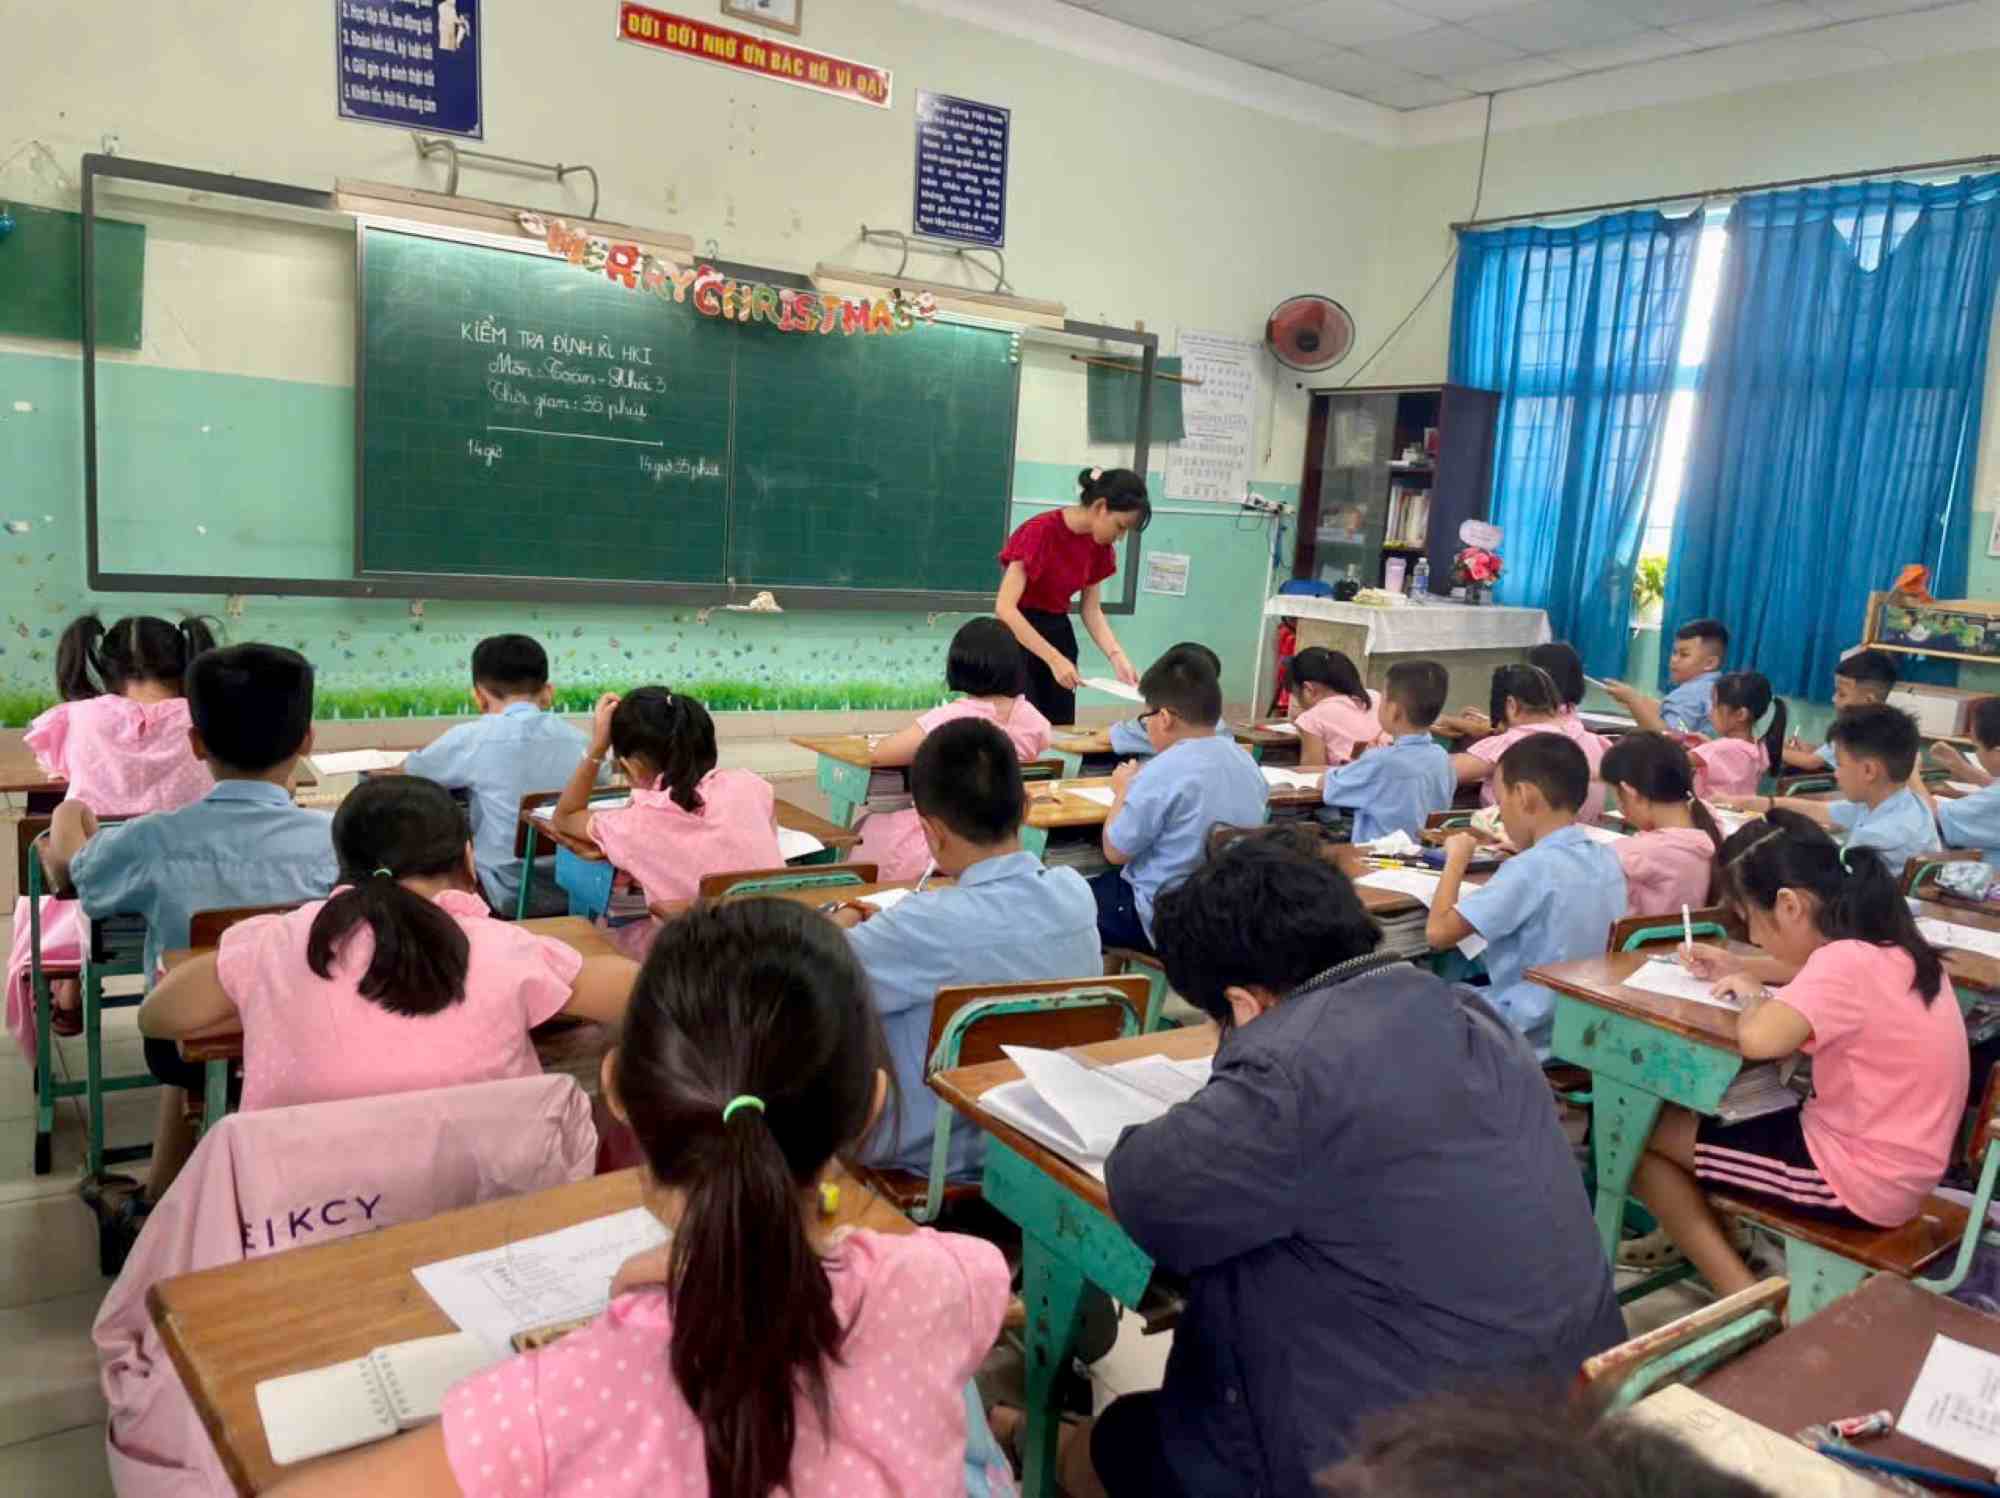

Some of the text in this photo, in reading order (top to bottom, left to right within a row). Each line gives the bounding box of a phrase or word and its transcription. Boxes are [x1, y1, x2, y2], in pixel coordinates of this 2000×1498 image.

[695, 264, 916, 336] CHRISTMAS
[518, 329, 545, 351] TRA
[622, 345, 653, 365] HKI
[582, 393, 604, 413] 35
